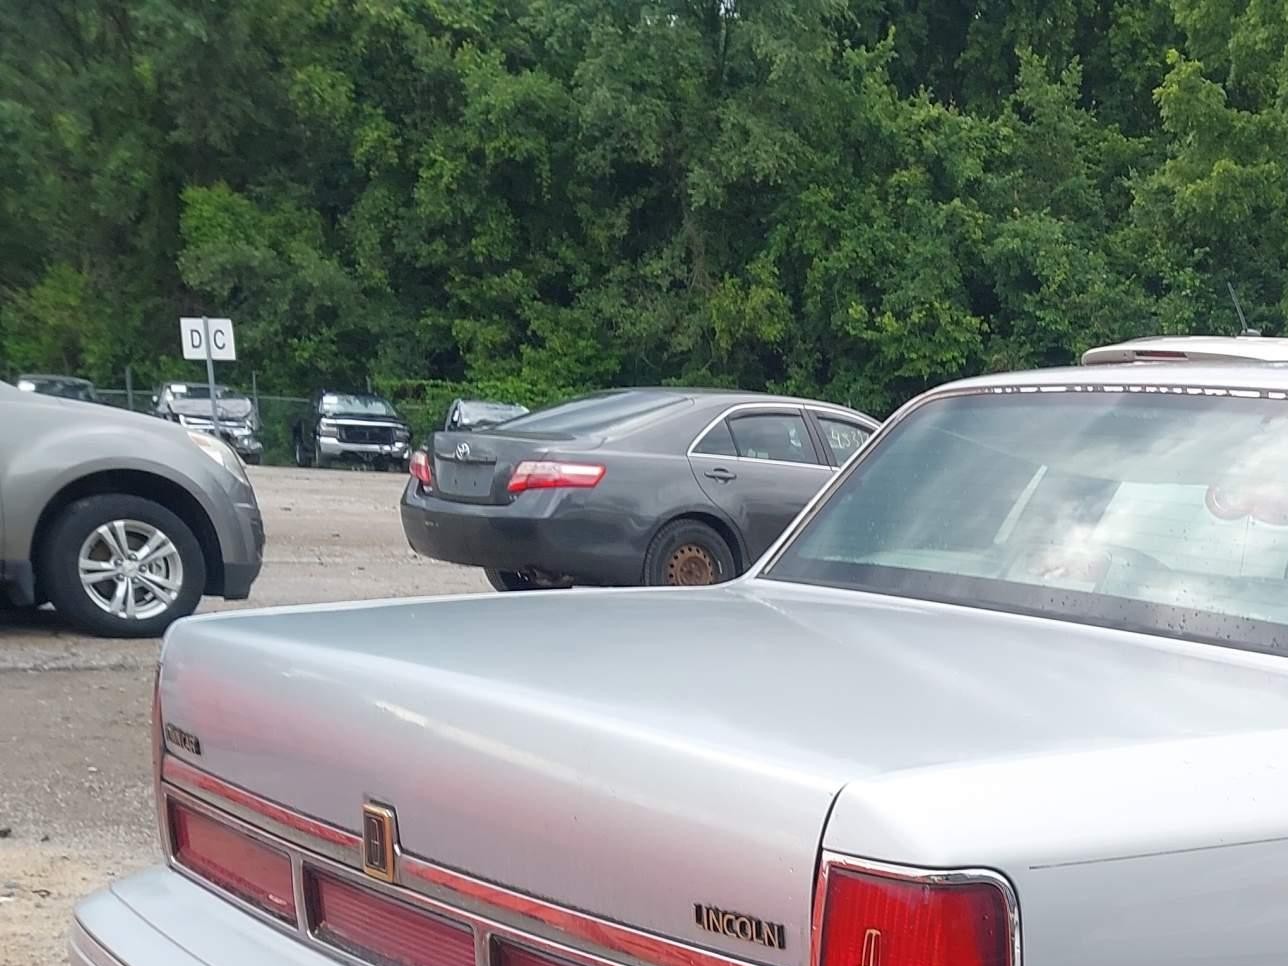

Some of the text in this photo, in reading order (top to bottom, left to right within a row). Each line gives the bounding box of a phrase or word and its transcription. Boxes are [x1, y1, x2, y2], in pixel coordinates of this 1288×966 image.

[190, 329, 202, 349] D
[213, 329, 226, 350] C
[694, 903, 785, 949] LINCOLN
